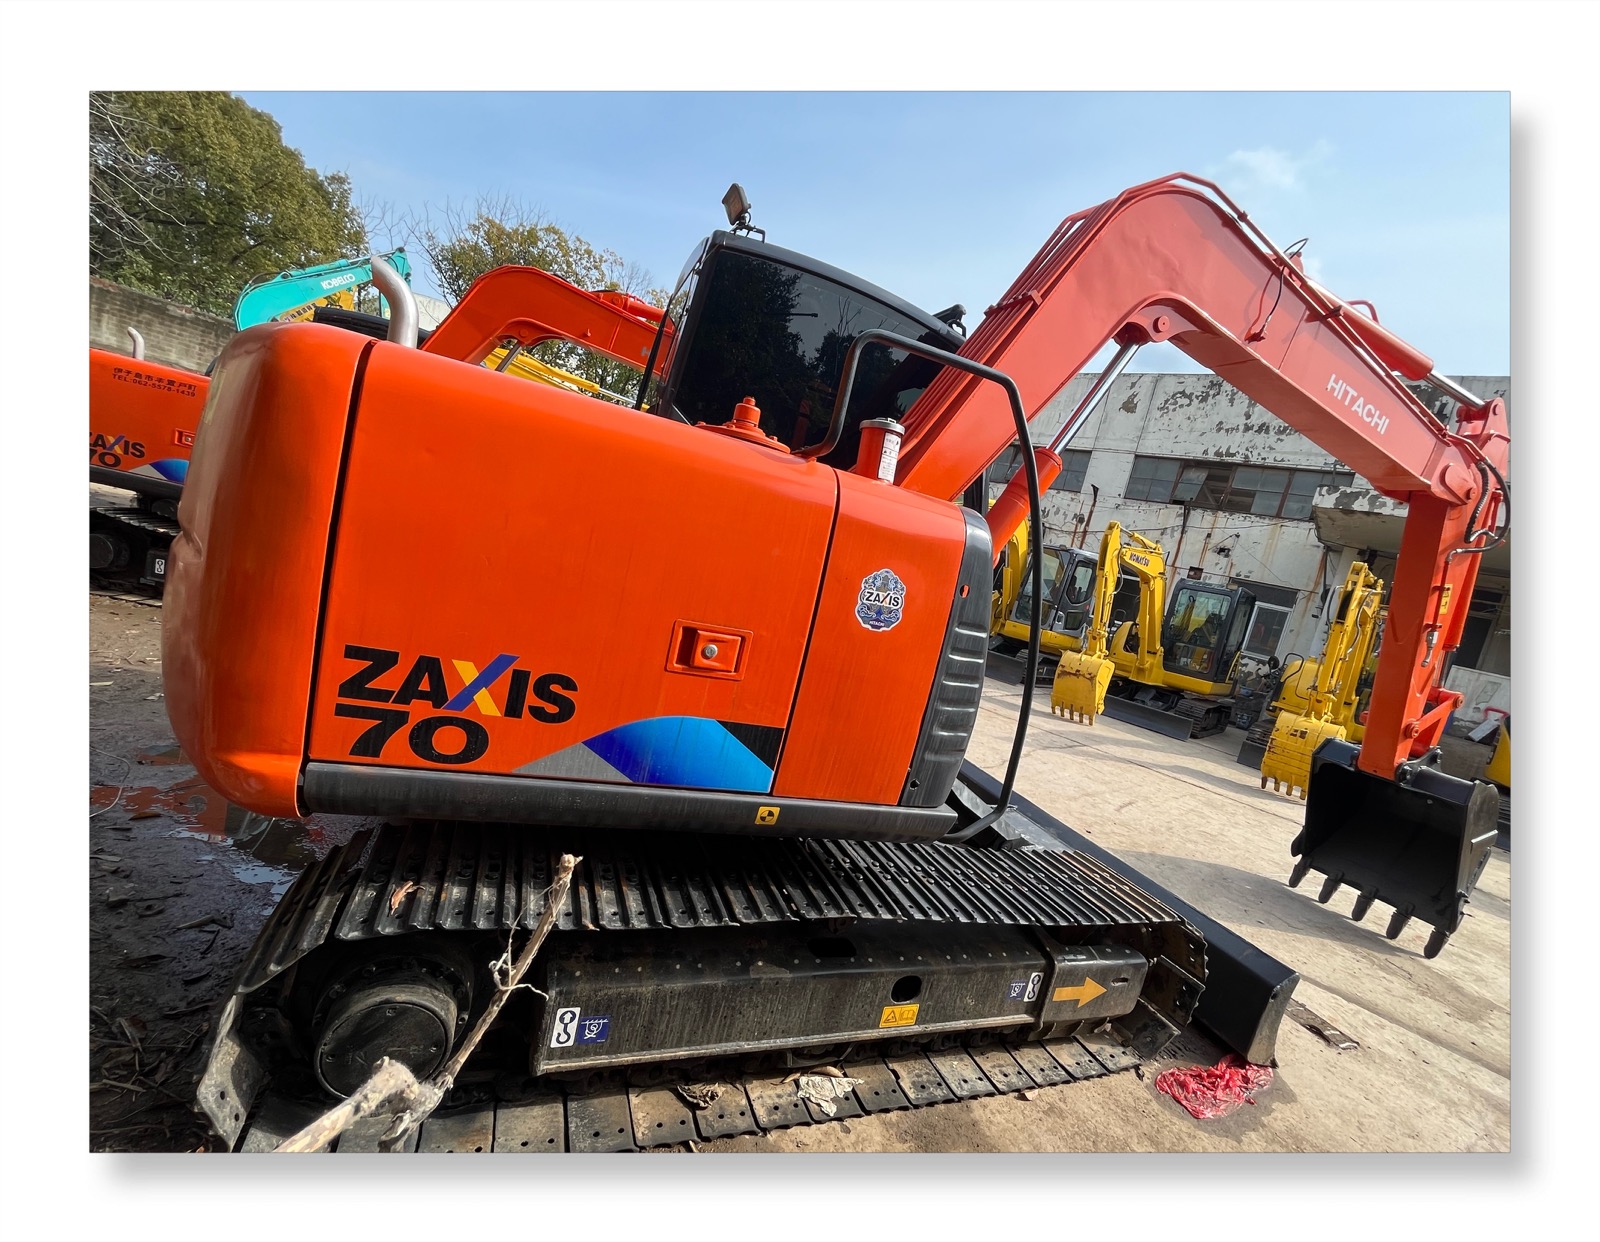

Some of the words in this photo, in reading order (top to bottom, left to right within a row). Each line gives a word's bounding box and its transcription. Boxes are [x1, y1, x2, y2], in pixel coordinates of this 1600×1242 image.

[320, 273, 356, 290] KOBELCO
[1326, 373, 1390, 435] HITACHI
[89, 431, 146, 459] AXIS
[865, 591, 901, 607] ZAXIS
[337, 644, 579, 725] ZAXIS
[334, 703, 490, 765] 70
